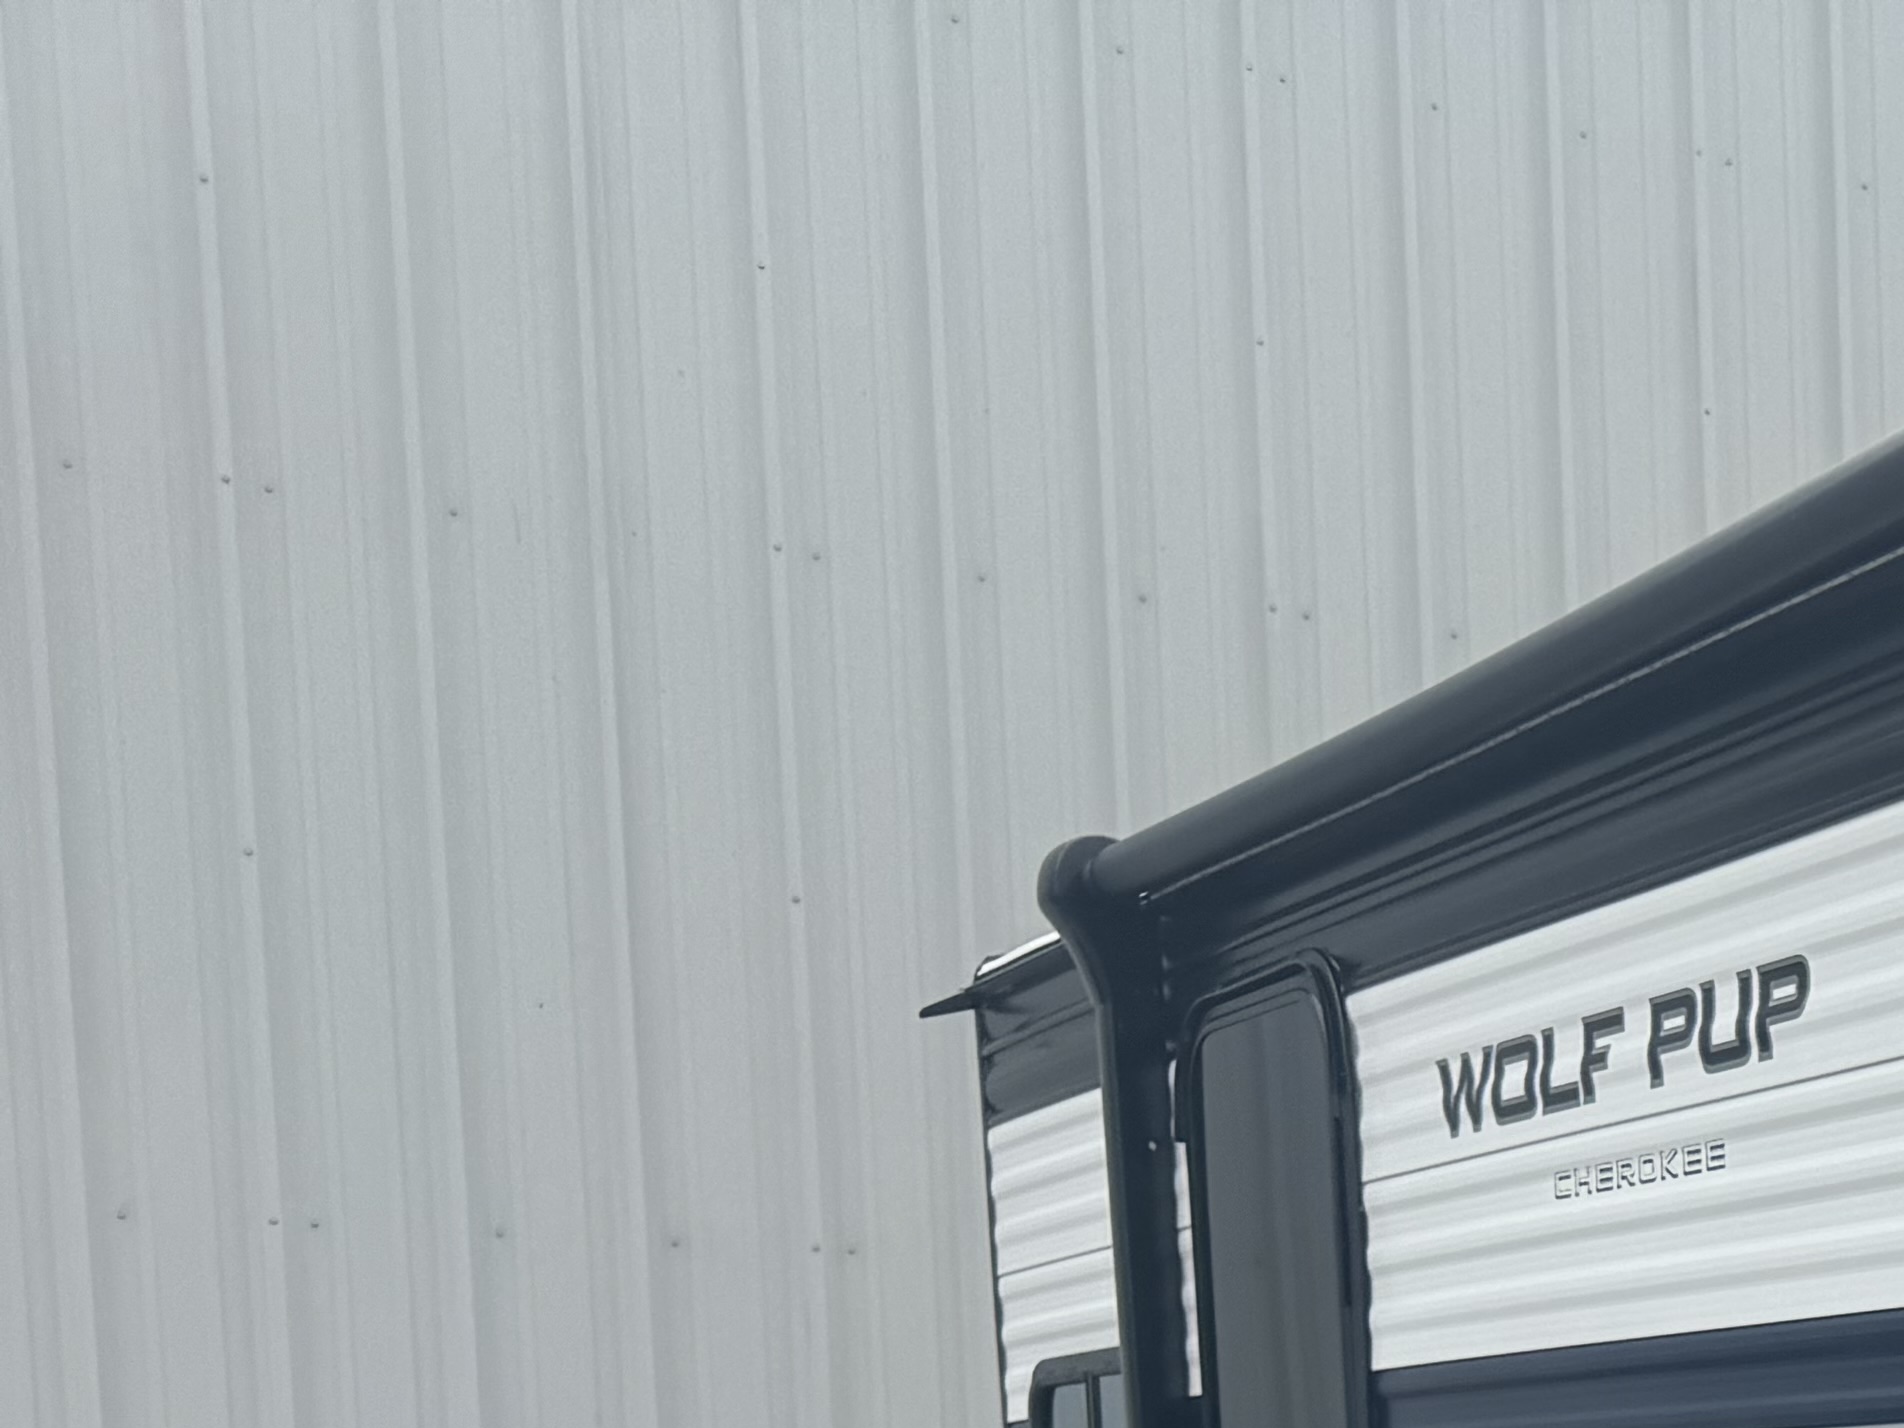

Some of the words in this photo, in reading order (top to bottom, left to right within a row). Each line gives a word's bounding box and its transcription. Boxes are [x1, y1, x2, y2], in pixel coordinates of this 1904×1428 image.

[1436, 1006, 1625, 1138] WOLF
[1648, 954, 1811, 1089] PUP
[1553, 1138, 1726, 1200] CHEROKEE
